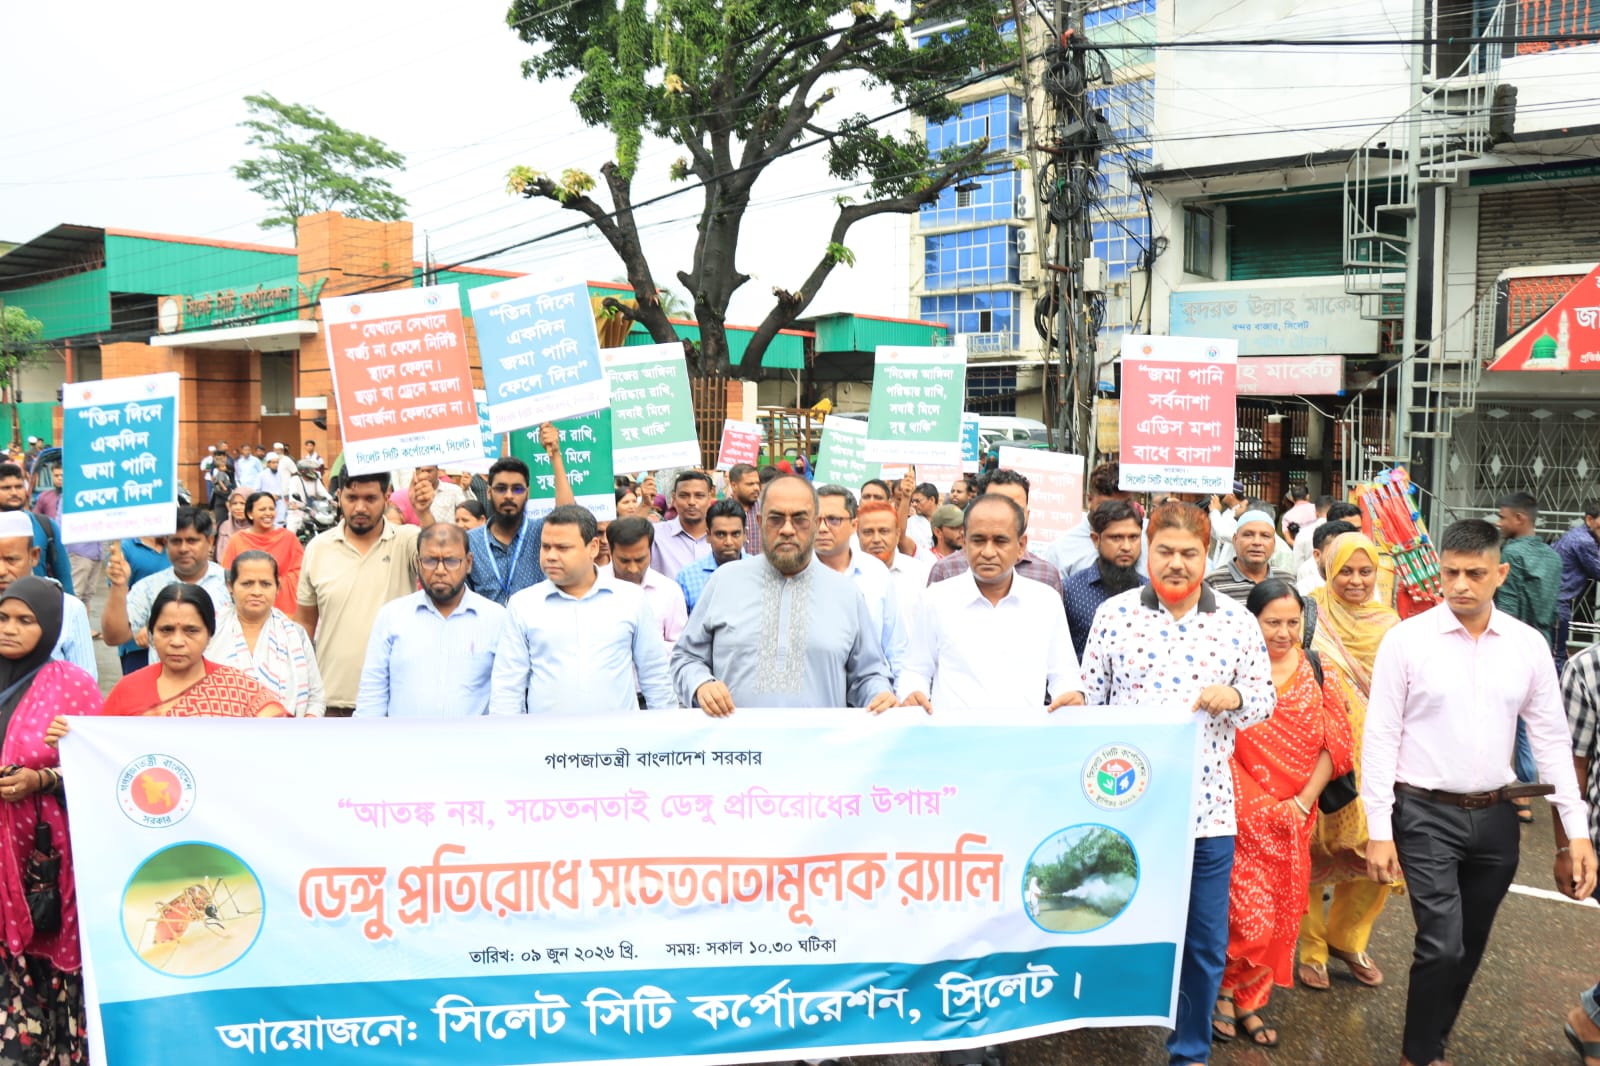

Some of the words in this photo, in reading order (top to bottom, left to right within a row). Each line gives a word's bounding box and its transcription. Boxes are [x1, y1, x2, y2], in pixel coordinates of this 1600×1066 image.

[489, 303, 531, 324] “তিন
[536, 292, 575, 315] দিনে
[1181, 300, 1238, 324] কুদরত
[363, 319, 403, 339] যেখানে
[406, 313, 448, 333] সেখানে
[506, 318, 566, 345] একদিন
[373, 343, 387, 359] না
[390, 339, 422, 356] ফেলে
[499, 350, 535, 371] জমা
[541, 337, 579, 361] পানি
[498, 374, 543, 398] ফেলে
[547, 360, 588, 386] দিন”
[1138, 364, 1181, 385] “জমা
[1188, 365, 1224, 385] পানি
[1267, 358, 1337, 381] মার্কেট
[381, 386, 394, 401] বা
[1147, 389, 1210, 412] সর্বনাশা
[78, 406, 120, 428] “তিন
[124, 402, 163, 424] দিনে
[349, 406, 397, 429] আবর্জনা
[400, 402, 448, 423] ফেলবেন
[616, 406, 644, 420] সবাই
[647, 403, 670, 417] মিলে
[889, 402, 915, 416] সবাই
[918, 401, 940, 416] মিলে
[570, 424, 597, 443] রাখি,
[1137, 416, 1184, 436] এডিস
[1189, 421, 1221, 438] মশা
[91, 428, 150, 453] একদিন
[80, 460, 116, 480] জমা
[121, 452, 157, 476] পানি
[356, 449, 380, 464] সিলেট
[383, 446, 399, 460] সিটি
[565, 448, 592, 464] মিলে
[1132, 445, 1170, 462] বাধে
[1176, 445, 1221, 464] বাসা”
[1125, 474, 1146, 486] সিলেট
[1148, 475, 1162, 486] সিটি
[75, 487, 119, 508] ফেলে
[123, 479, 163, 502] দিন”
[636, 750, 706, 768] বাংলাদেশ
[711, 749, 762, 767] সরকার
[337, 798, 437, 829] “আতঙ্ক
[444, 800, 495, 831] নয়,
[504, 788, 651, 824] সচেতনতাই
[660, 794, 717, 826] ডেঙ্গু
[723, 785, 862, 820] প্রতিরোধের
[870, 784, 957, 817] উপায়”
[298, 866, 394, 940] ডেঙ্গু
[398, 842, 583, 924] প্রতিরোধে
[590, 852, 888, 927] সচেতনতামূলক
[469, 946, 515, 965] তারিখ:
[521, 948, 542, 963] ০৯
[546, 946, 569, 966] জুন
[575, 945, 615, 961] ২০২৬
[620, 940, 639, 961] খ্রি.
[666, 942, 701, 957] সময়:
[706, 940, 743, 956] সকাল
[750, 939, 793, 955] ১০.৩০
[798, 935, 837, 954] ঘটিকা
[215, 1014, 417, 1055] আয়োজনে:
[430, 989, 571, 1044] সিলেট
[581, 985, 676, 1037] সিটি
[686, 979, 922, 1032] কর্পোরেশন,
[934, 962, 1060, 1021] সিলেট
